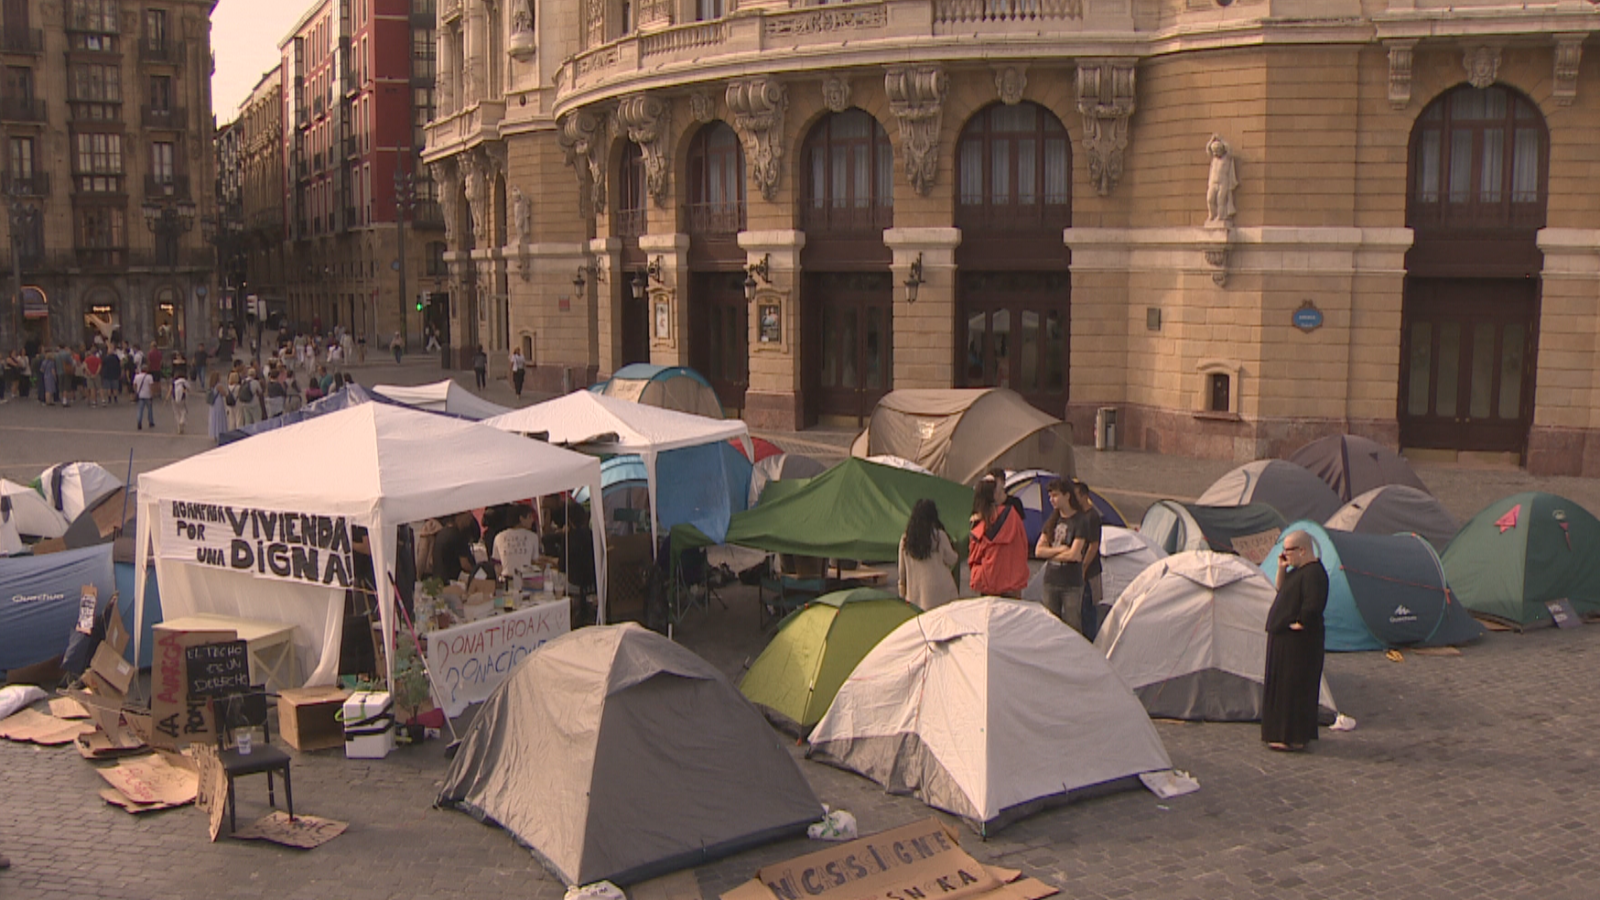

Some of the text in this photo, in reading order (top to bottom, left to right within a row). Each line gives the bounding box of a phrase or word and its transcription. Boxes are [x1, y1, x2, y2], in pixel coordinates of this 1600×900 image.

[177, 520, 205, 541] POR
[224, 506, 351, 554] VIVIENDA
[197, 546, 225, 567] UNA
